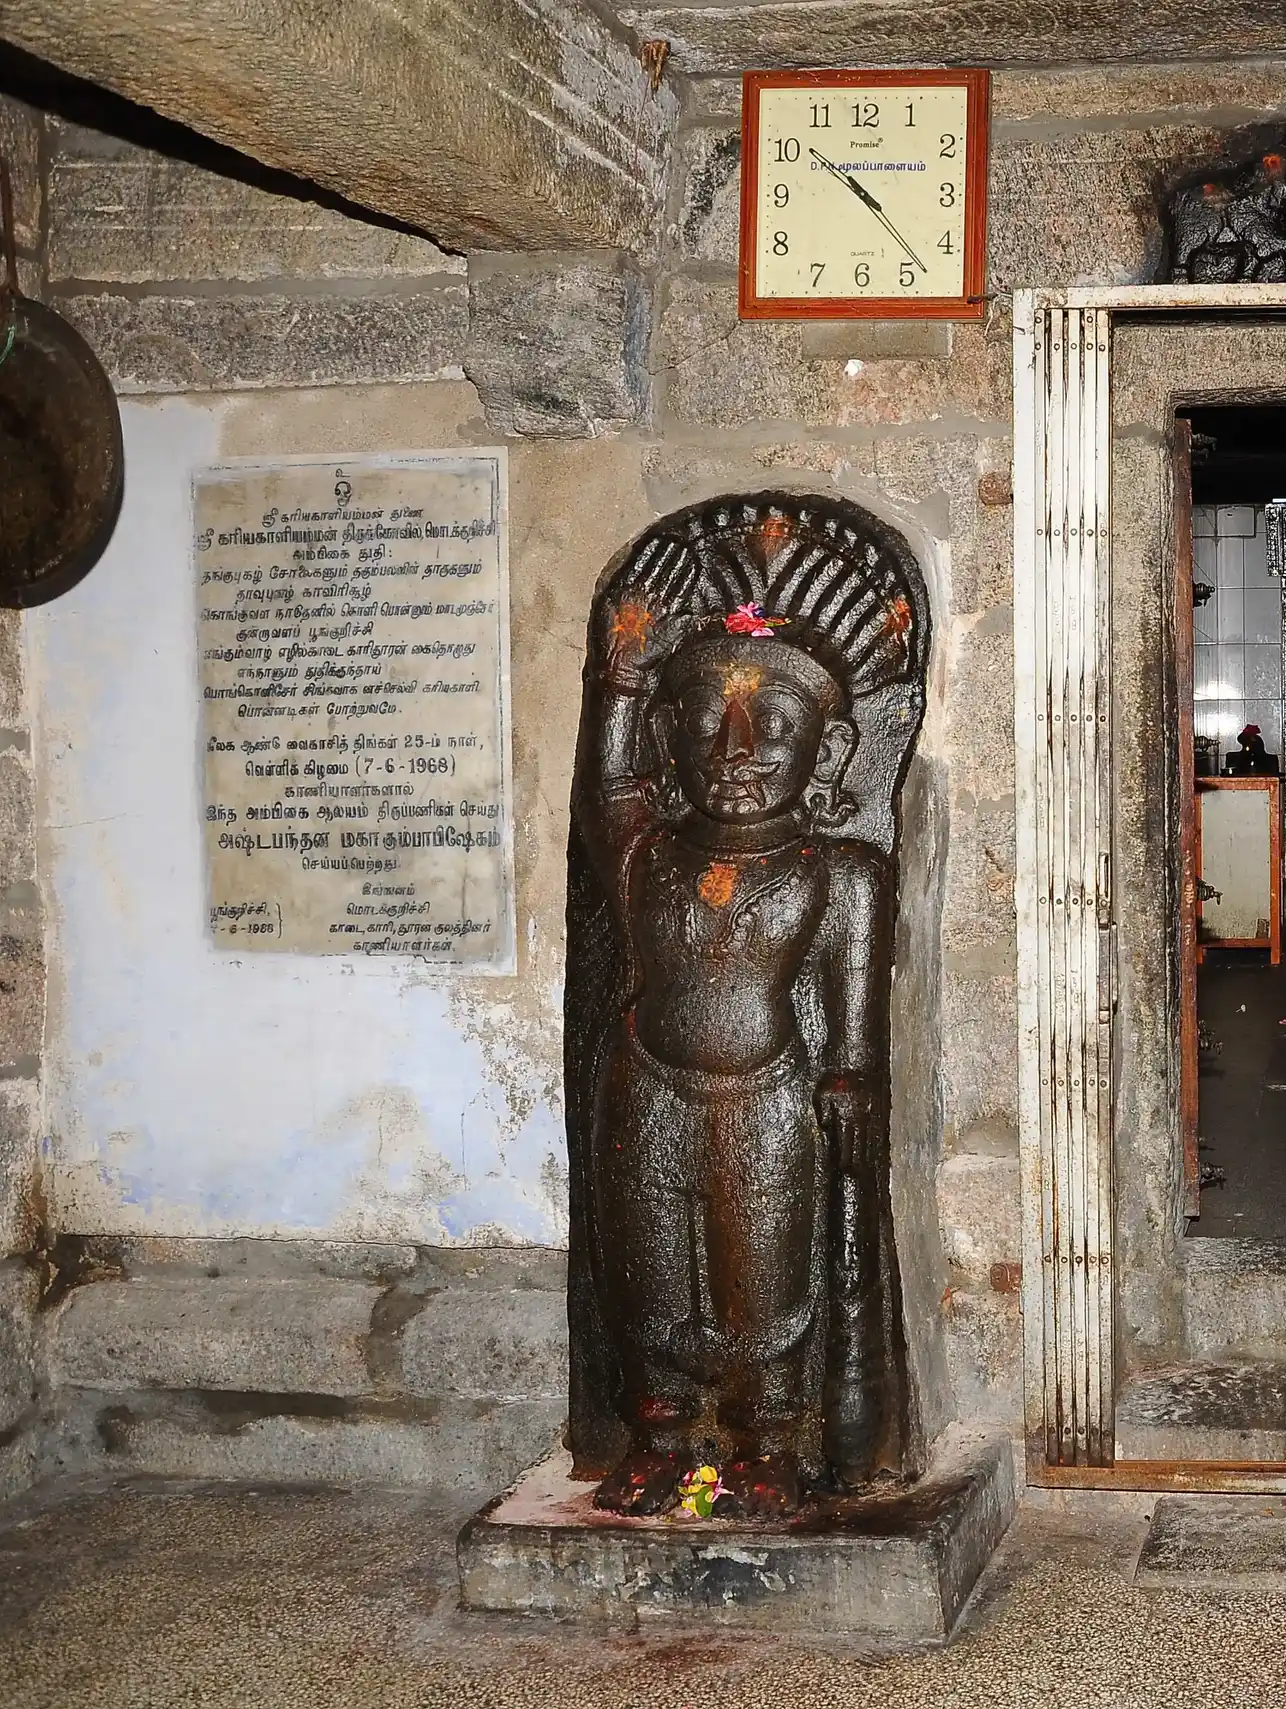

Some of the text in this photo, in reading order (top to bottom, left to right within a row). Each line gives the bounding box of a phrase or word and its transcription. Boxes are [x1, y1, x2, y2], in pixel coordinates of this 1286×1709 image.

[852, 103, 879, 127] 12
[774, 138, 800, 162] 10
[940, 134, 956, 158] 2
[774, 184, 789, 208] 9
[940, 183, 955, 207] 3
[773, 231, 789, 255] 8
[937, 230, 953, 254] 4
[810, 263, 915, 287] 7 6 5
